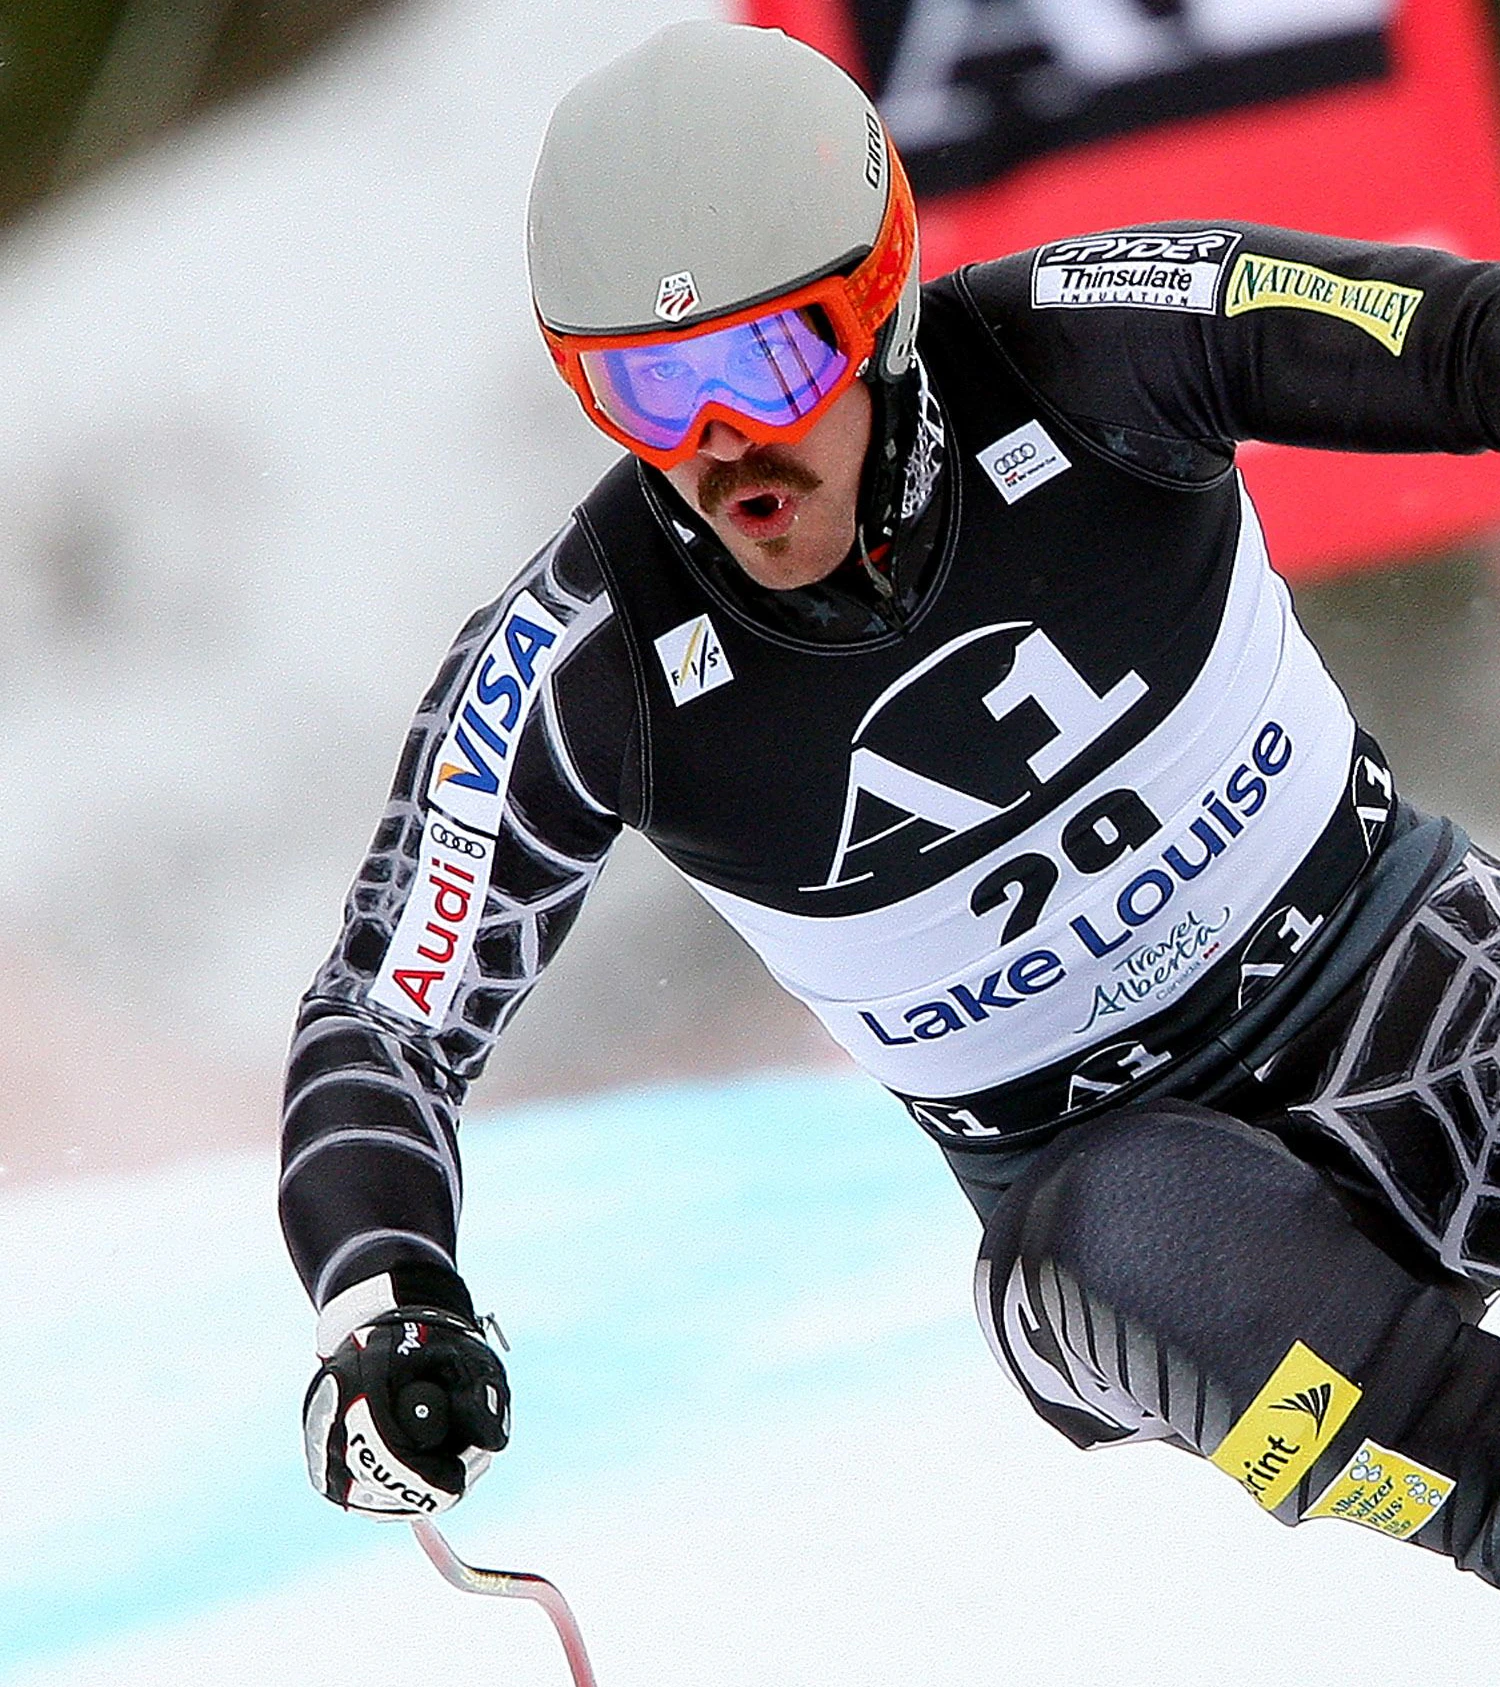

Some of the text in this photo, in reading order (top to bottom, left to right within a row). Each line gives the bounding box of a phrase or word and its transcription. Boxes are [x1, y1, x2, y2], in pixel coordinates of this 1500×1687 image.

[865, 112, 881, 189] GIRO
[1046, 235, 1226, 263] SPYDER
[1061, 265, 1193, 291] Thinsulate
[1060, 293, 1189, 305] INSULATION
[1232, 259, 1418, 341] NATURE VALLEY
[434, 614, 557, 796] VISA
[798, 620, 1150, 892] A1
[857, 720, 1294, 1047] Lake Louise
[969, 787, 1164, 948] 29
[391, 857, 476, 1016] Audi
[1073, 906, 1231, 1034] Alberta
[1112, 910, 1202, 976] Travel
[1155, 961, 1201, 1001] Canada
[1059, 1040, 1173, 1117] A1
[348, 1432, 440, 1513] reusch
